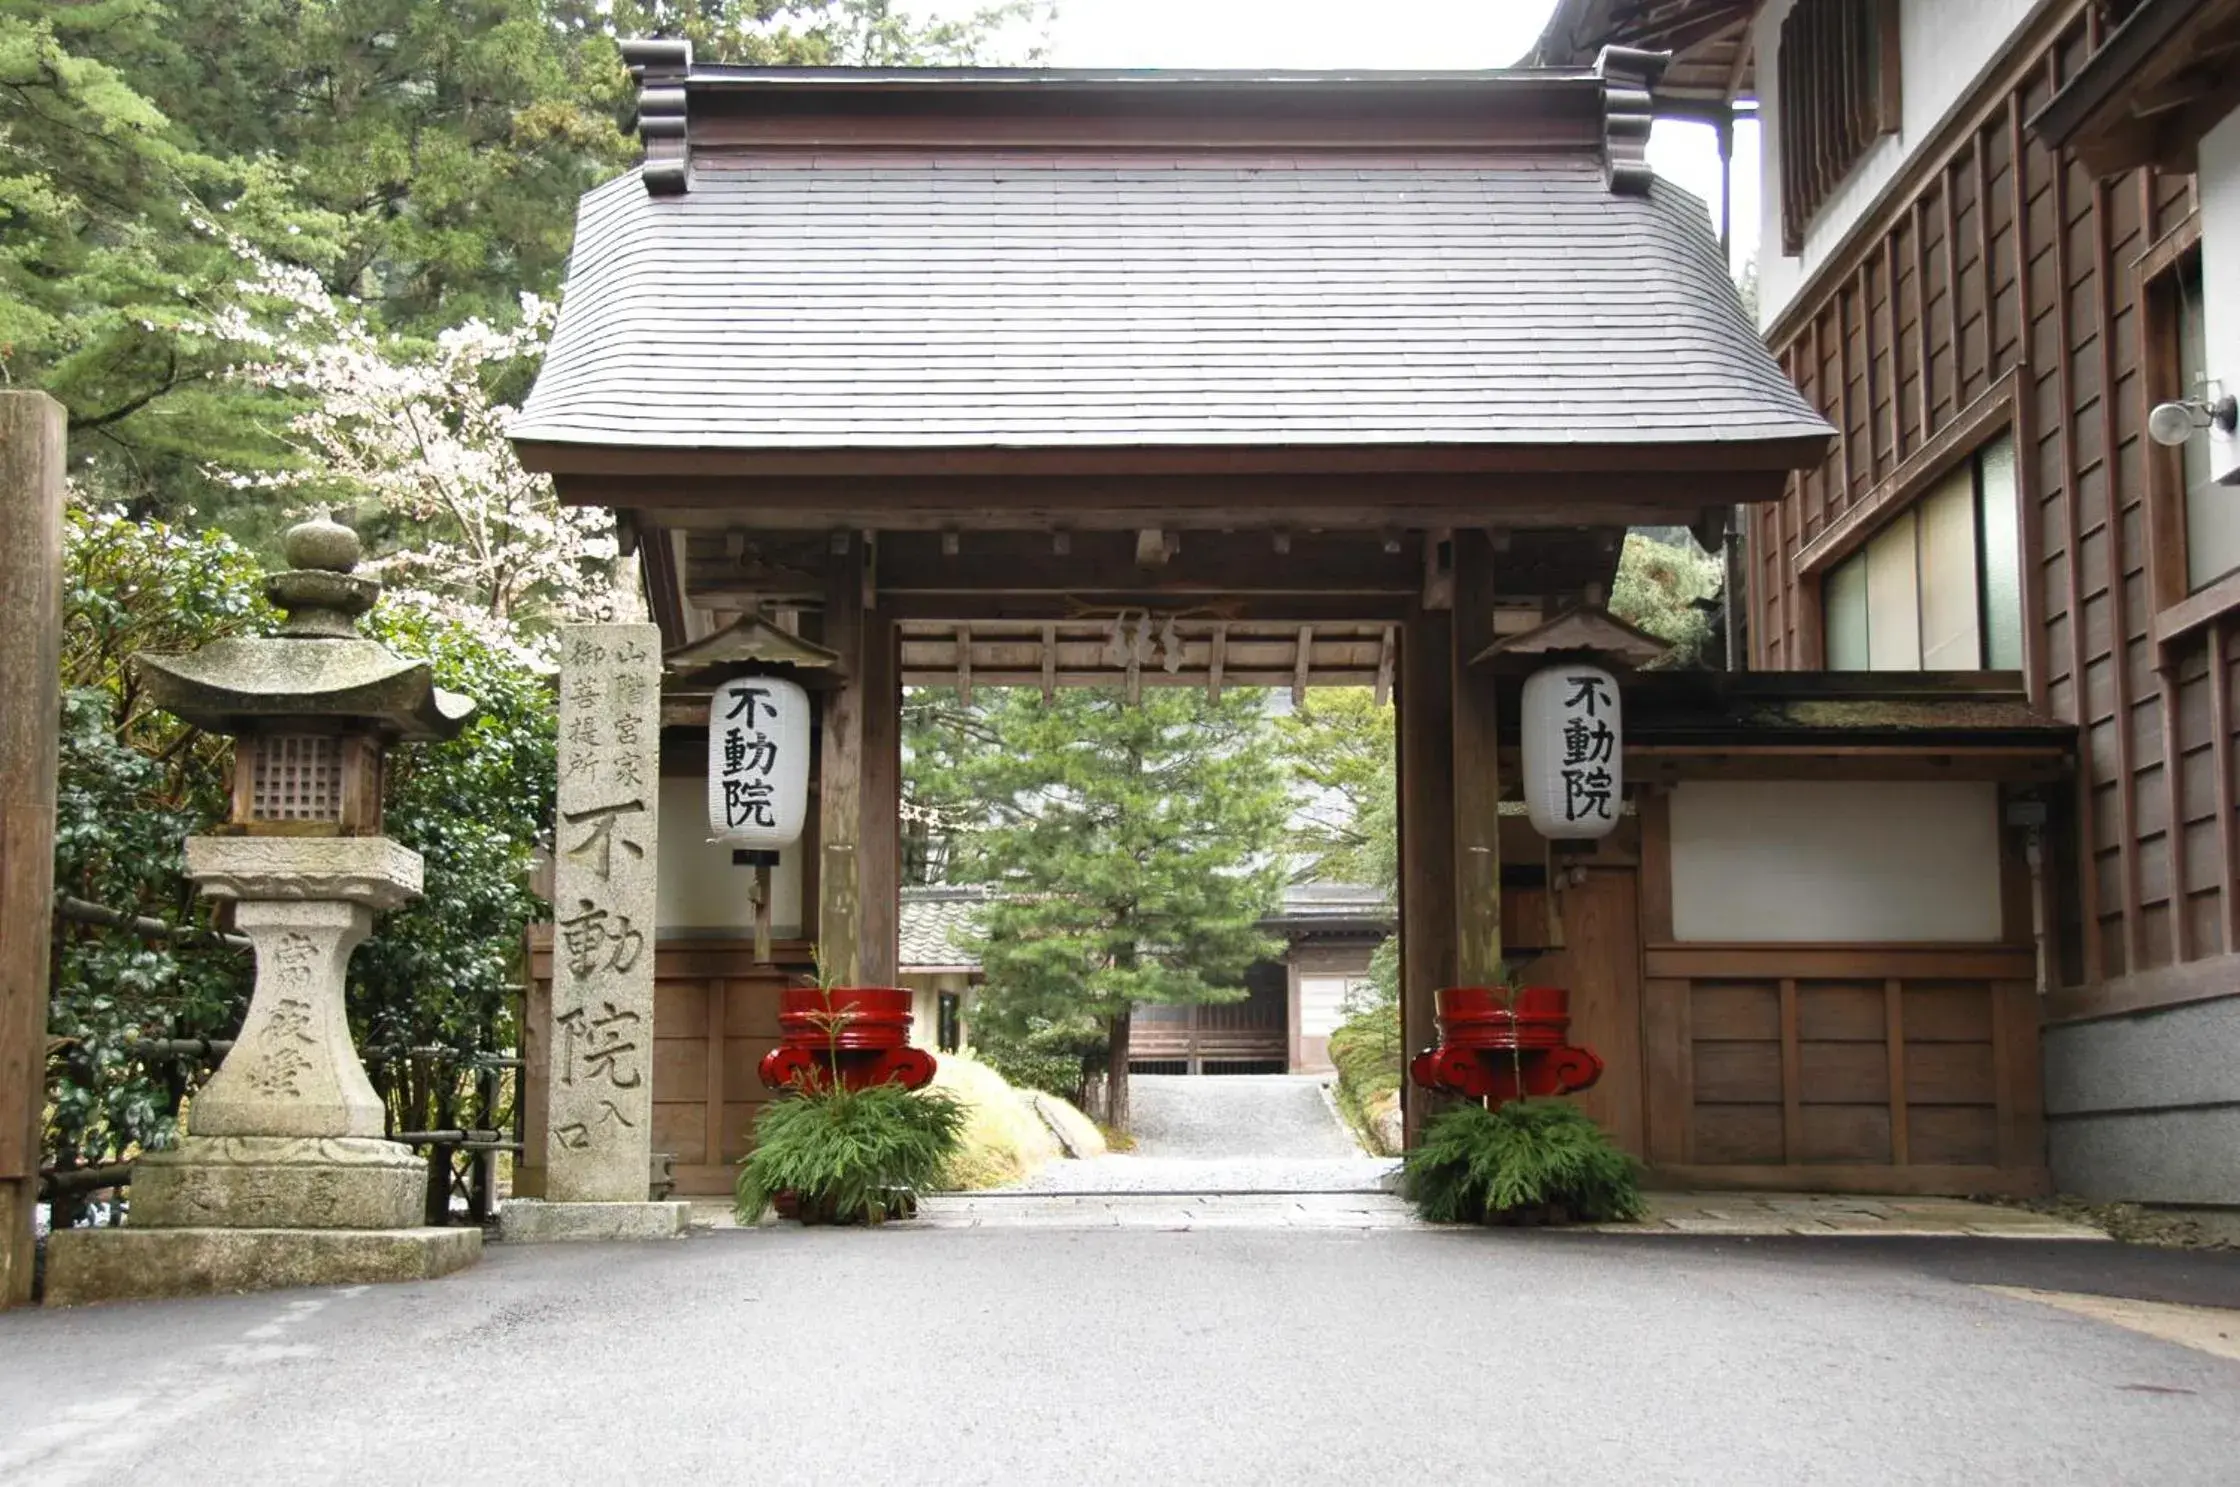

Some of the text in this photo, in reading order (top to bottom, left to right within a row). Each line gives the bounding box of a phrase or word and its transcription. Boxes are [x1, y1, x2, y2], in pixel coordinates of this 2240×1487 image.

[565, 639, 606, 785] 御菩提所
[613, 640, 648, 787] 山階宮家
[722, 687, 778, 829] 不動院
[1561, 676, 1615, 822] 不動院
